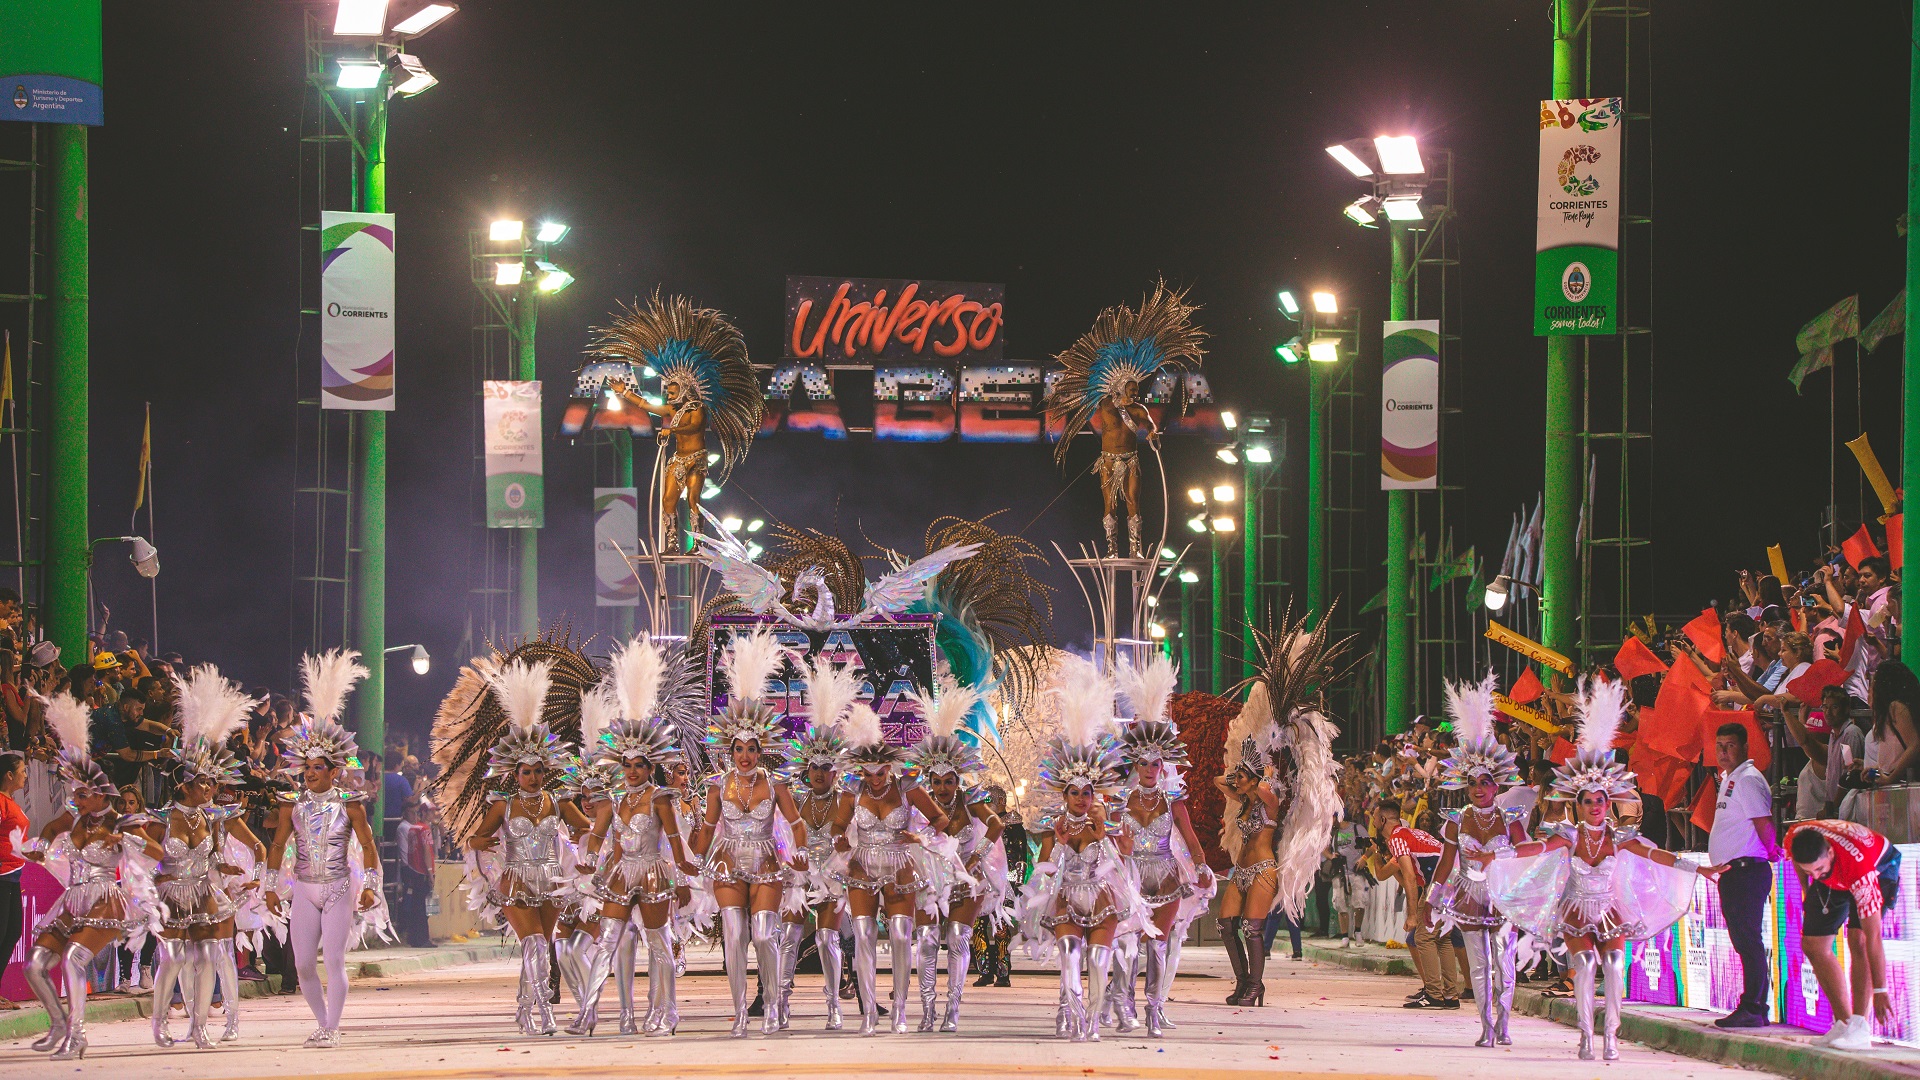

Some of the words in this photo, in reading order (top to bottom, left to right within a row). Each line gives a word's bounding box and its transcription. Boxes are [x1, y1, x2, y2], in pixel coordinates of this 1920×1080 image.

[32, 101, 65, 110] Argentina
[1549, 200, 1608, 210] CORRIENTES
[342, 310, 388, 319] CORRIENTES
[1544, 305, 1607, 319] CORRIENTES
[791, 282, 1003, 358] Universo
[1397, 403, 1433, 411] CORRIENTES
